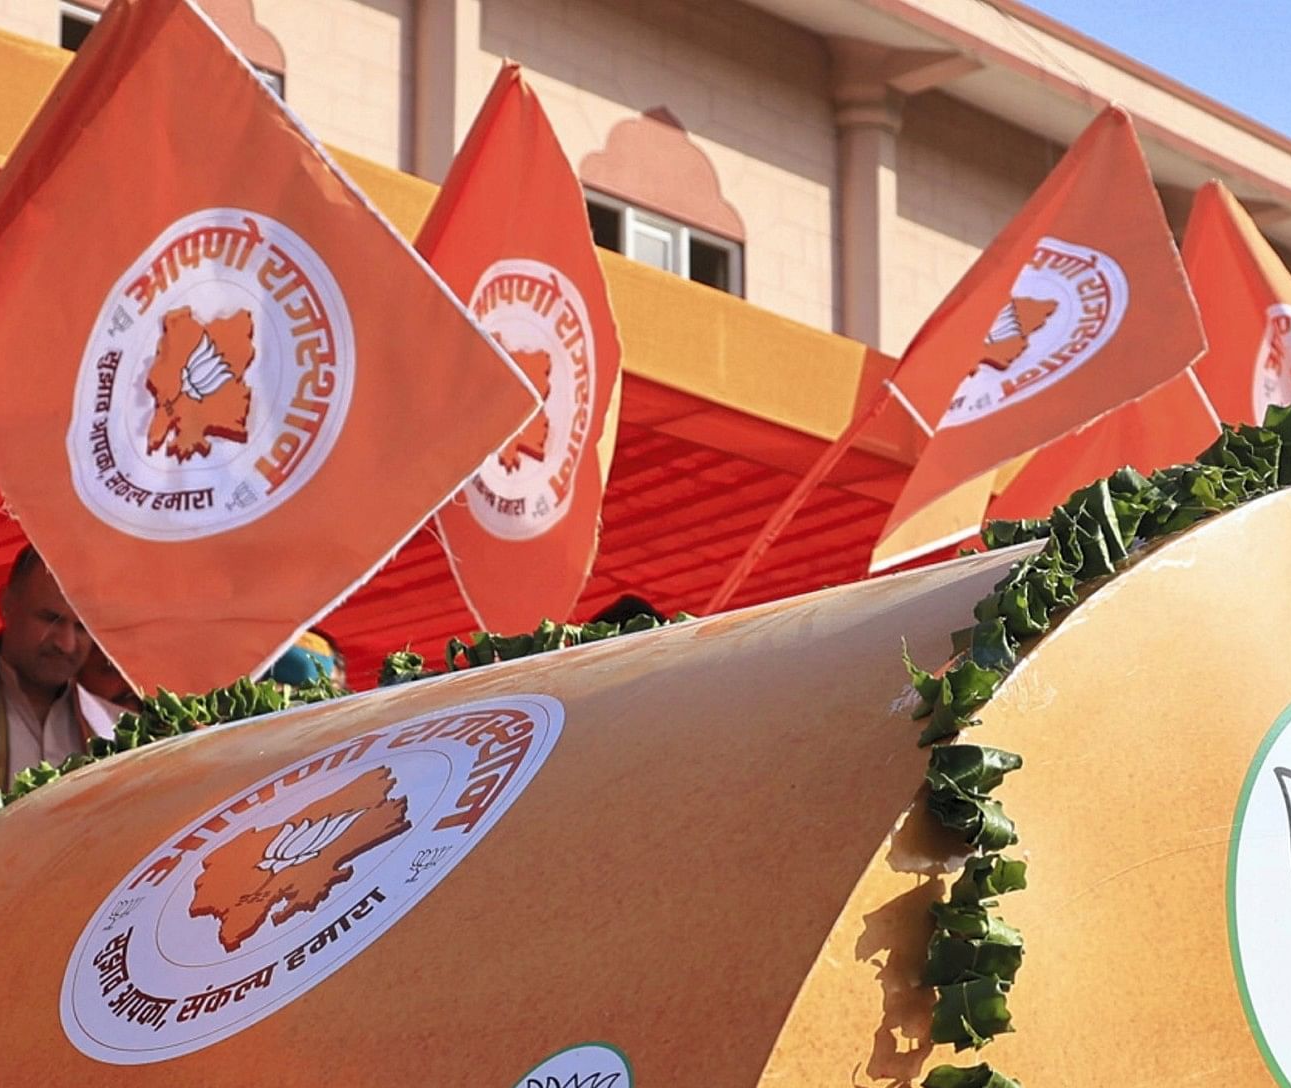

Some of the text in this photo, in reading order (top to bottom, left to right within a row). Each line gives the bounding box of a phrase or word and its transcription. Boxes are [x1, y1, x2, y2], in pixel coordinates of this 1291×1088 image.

[124, 217, 337, 495] आपणो राजस्थान
[151, 488, 214, 511] हमारा
[127, 708, 534, 890] आपणो राजस्थान
[93, 886, 388, 1032] सुझाव आपका, संकल्प हमारा
